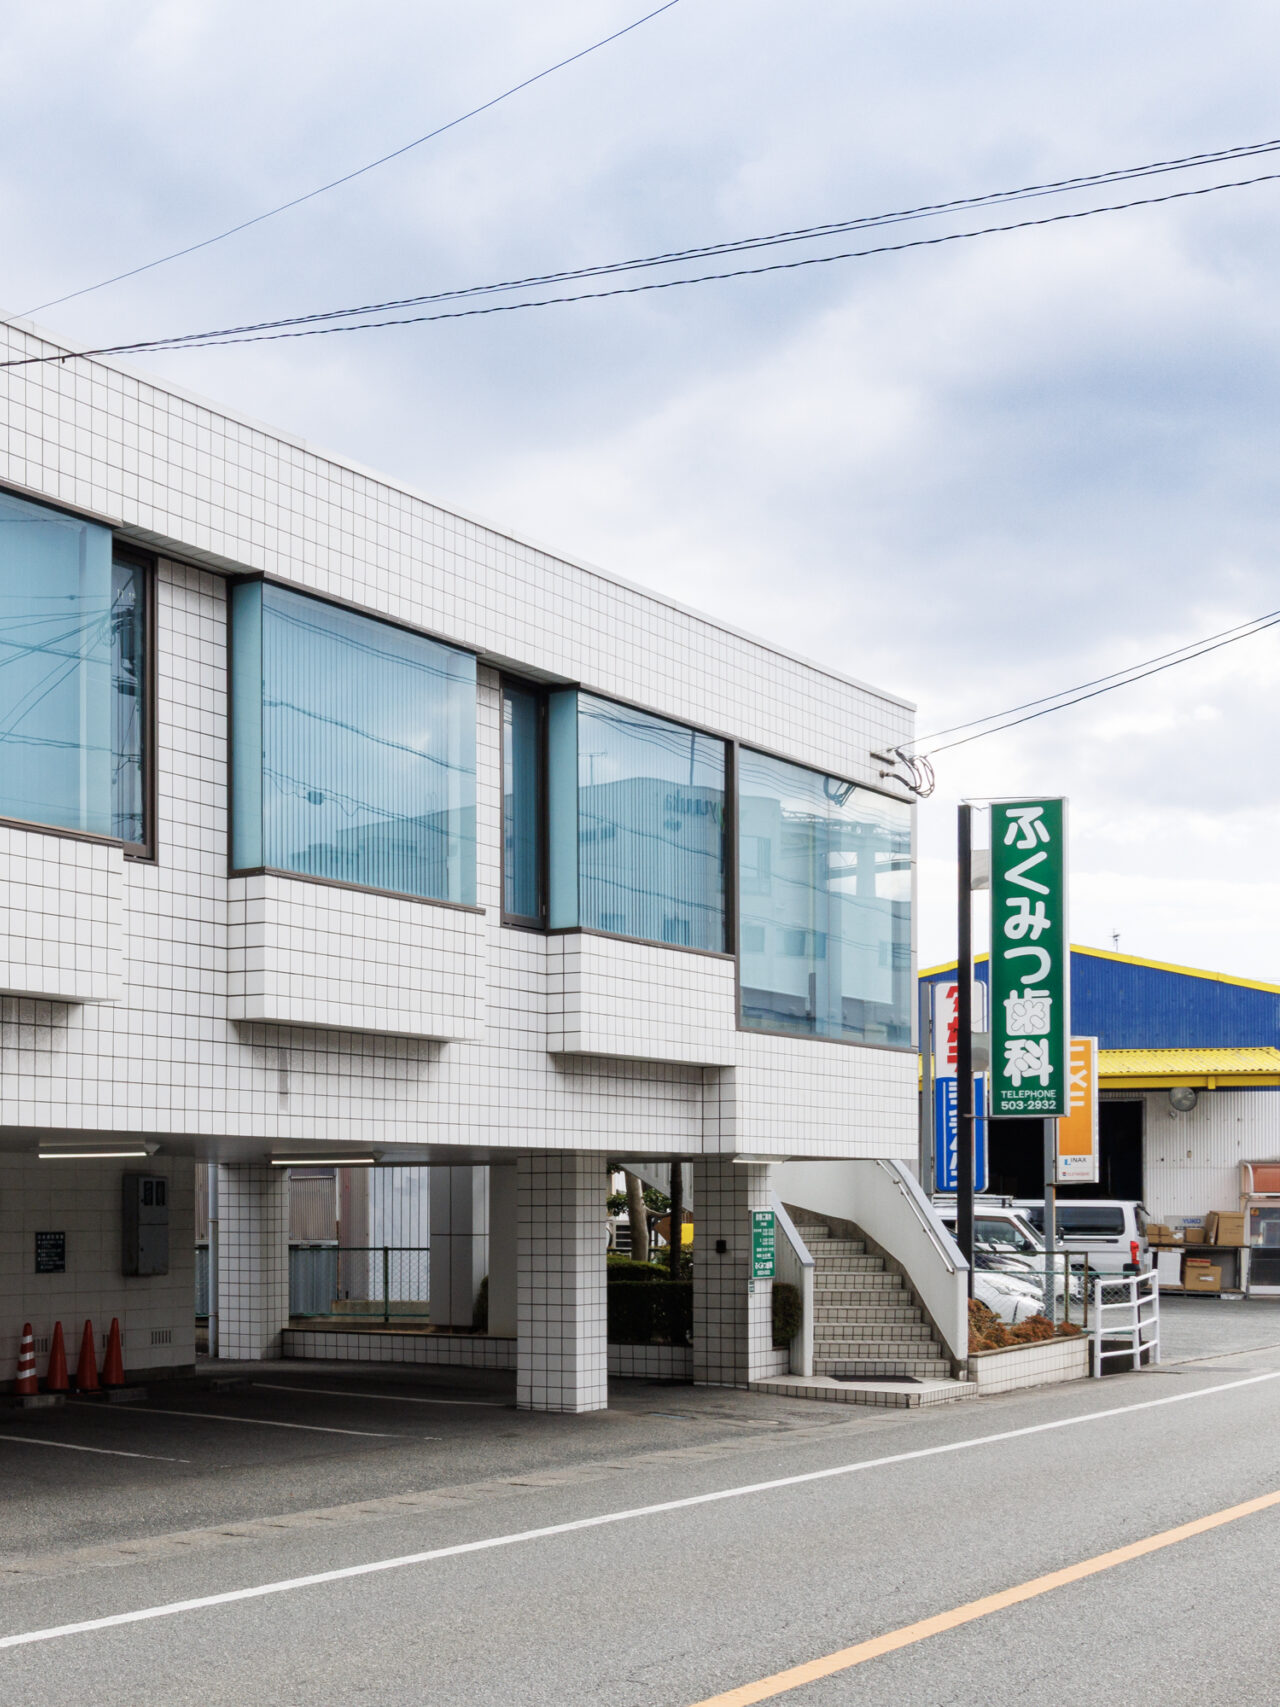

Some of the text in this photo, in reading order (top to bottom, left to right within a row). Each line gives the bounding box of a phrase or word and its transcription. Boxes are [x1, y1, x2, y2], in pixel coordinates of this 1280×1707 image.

[1003, 806, 1054, 1087] ふくみつ歯科
[1000, 1090, 1056, 1099] TELEPHONE
[1000, 1100, 1056, 1110] 503-2932
